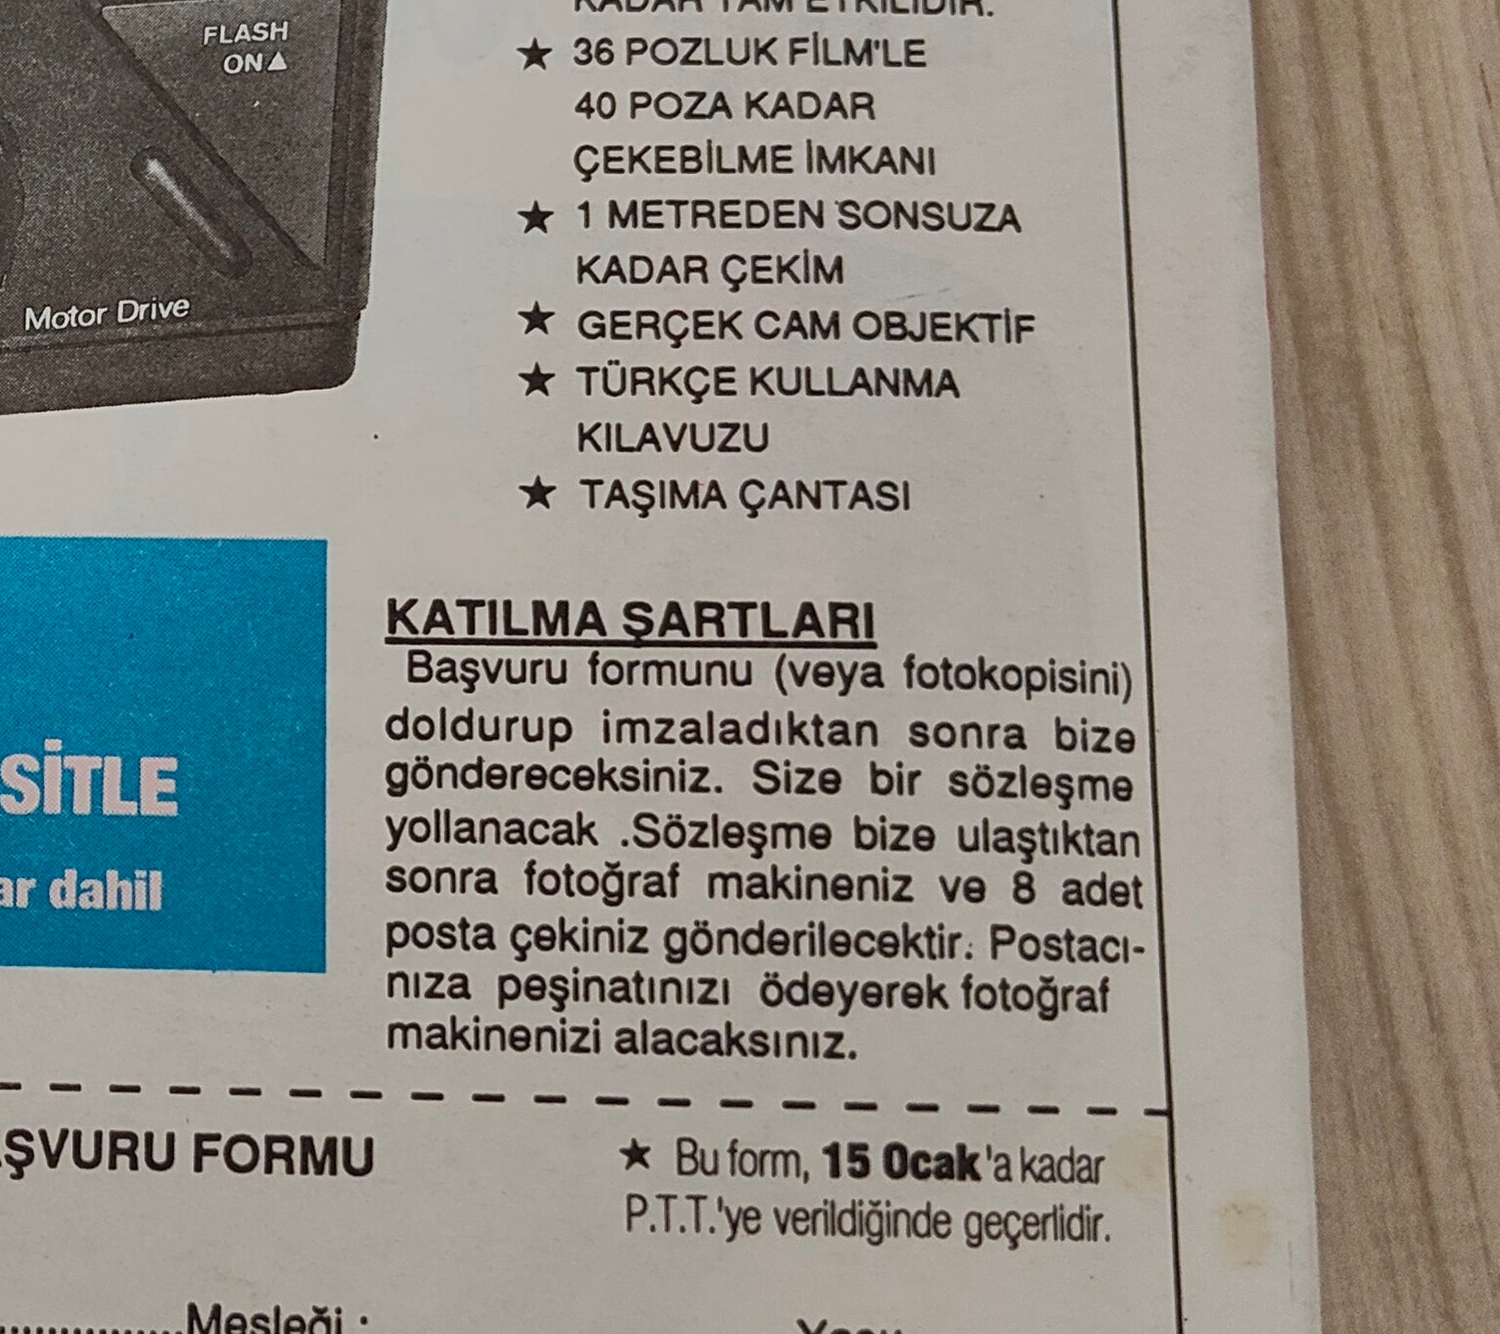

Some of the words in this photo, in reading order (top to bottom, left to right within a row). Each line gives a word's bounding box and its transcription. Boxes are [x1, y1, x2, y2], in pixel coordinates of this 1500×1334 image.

[203, 22, 289, 47] FLASH
[573, 37, 615, 66] 36
[626, 36, 778, 66] POZLUK
[789, 31, 927, 68] FİLM'LE
[574, 91, 617, 120] 40
[630, 90, 733, 120] POZA
[745, 90, 876, 121] KADAR
[573, 138, 794, 183] ÇEKEBİLME
[806, 138, 936, 176] İMKANI
[577, 200, 591, 229] 1
[608, 199, 825, 229] METREDEN
[834, 199, 1022, 234] SONSUZA
[577, 254, 709, 285] KADAR
[721, 248, 844, 293] ÇEKİM
[25, 304, 108, 332] Motor
[116, 294, 191, 327] Drive
[577, 309, 743, 349] GERÇEK
[754, 310, 841, 340] CAM
[852, 307, 1036, 344] OBJEKTİF
[575, 359, 738, 405] TÜRKÇE
[749, 366, 961, 399] KULLANMA
[578, 421, 769, 453] KILAVUZU
[579, 478, 728, 519] TAŞIMA
[739, 478, 910, 519] ÇANTASI
[387, 599, 607, 636] KATILMA
[623, 599, 875, 644] ŞARTLARI
[407, 649, 568, 694] Başvuru
[587, 650, 753, 687] formunu
[775, 652, 885, 697] (veya
[903, 653, 1132, 705] fotokopisini)
[49, 868, 163, 911] dahil
[387, 1014, 601, 1054] makinenizi
[614, 1018, 857, 1060] alacaksınız.
[193, 1132, 374, 1177] FORMU
[676, 1136, 719, 1177] Bu
[726, 1138, 810, 1185] form,
[822, 1141, 871, 1179] 15
[1019, 1145, 1106, 1185] kadar
[773, 1198, 952, 1247] verildiğinde
[963, 1203, 1111, 1251] geçerlidir.
